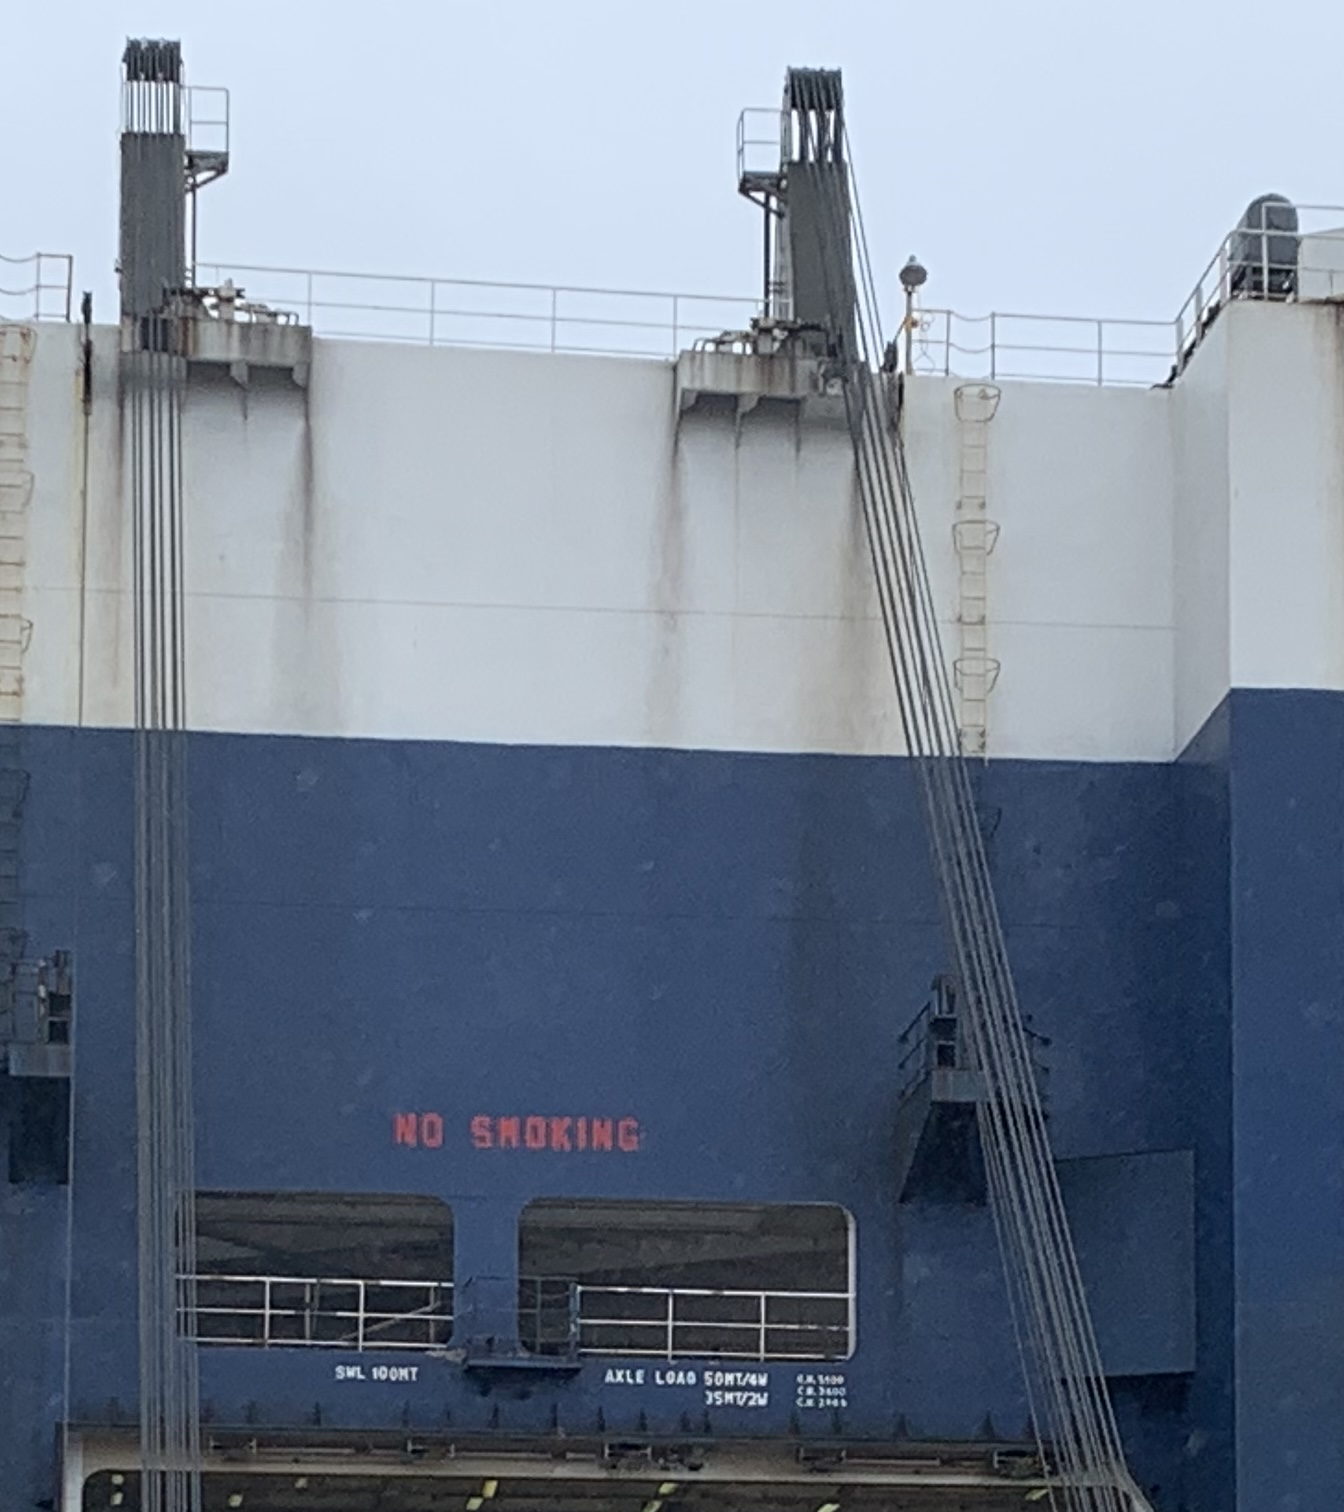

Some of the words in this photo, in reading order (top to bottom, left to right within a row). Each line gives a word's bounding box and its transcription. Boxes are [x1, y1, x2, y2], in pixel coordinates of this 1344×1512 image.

[394, 1112, 443, 1148] NO
[471, 1115, 639, 1151] SMOKING
[335, 1365, 366, 1380] SWL
[372, 1366, 418, 1381] 100MT
[605, 1369, 645, 1384] AXLE
[655, 1370, 696, 1385] LOAD
